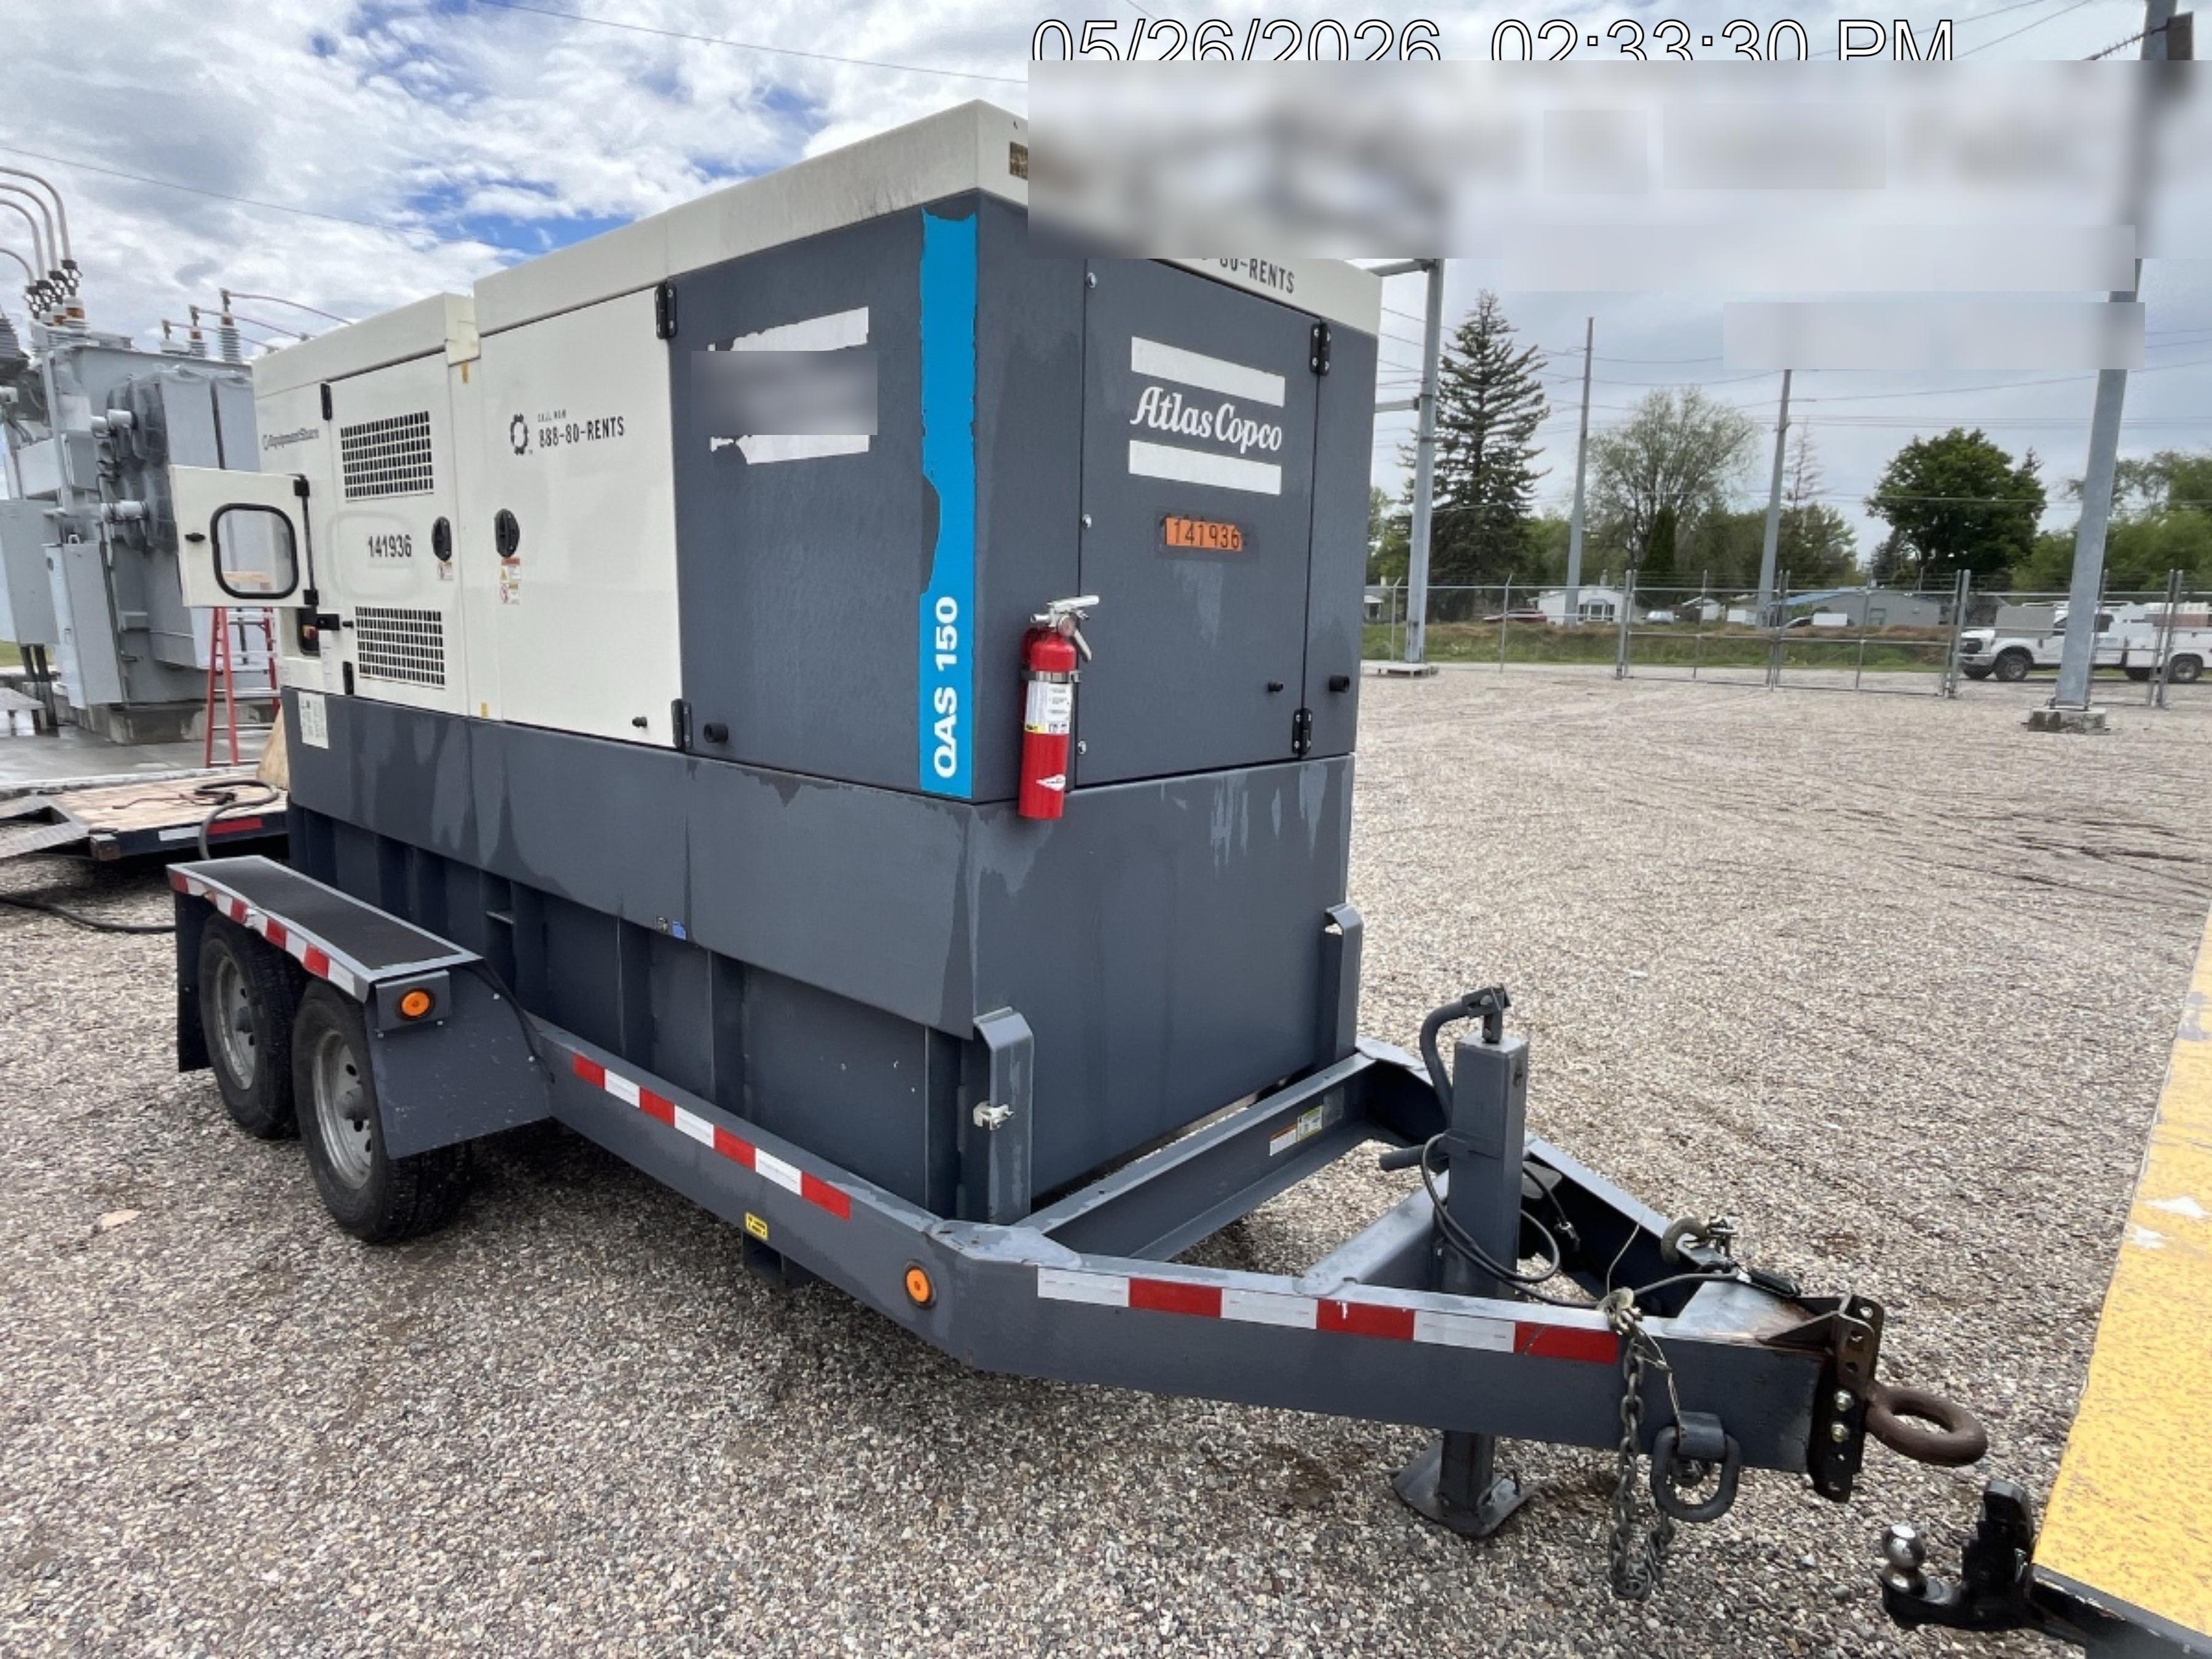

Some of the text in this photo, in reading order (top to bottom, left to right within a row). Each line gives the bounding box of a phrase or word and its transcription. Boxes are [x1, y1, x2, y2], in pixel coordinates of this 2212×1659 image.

[538, 415, 624, 448] 888-80-RENTS
[1129, 386, 1282, 454] Atlas Copco
[368, 534, 412, 558] 141936
[1174, 521, 1240, 549] 141936
[933, 596, 958, 779] QAS 150
